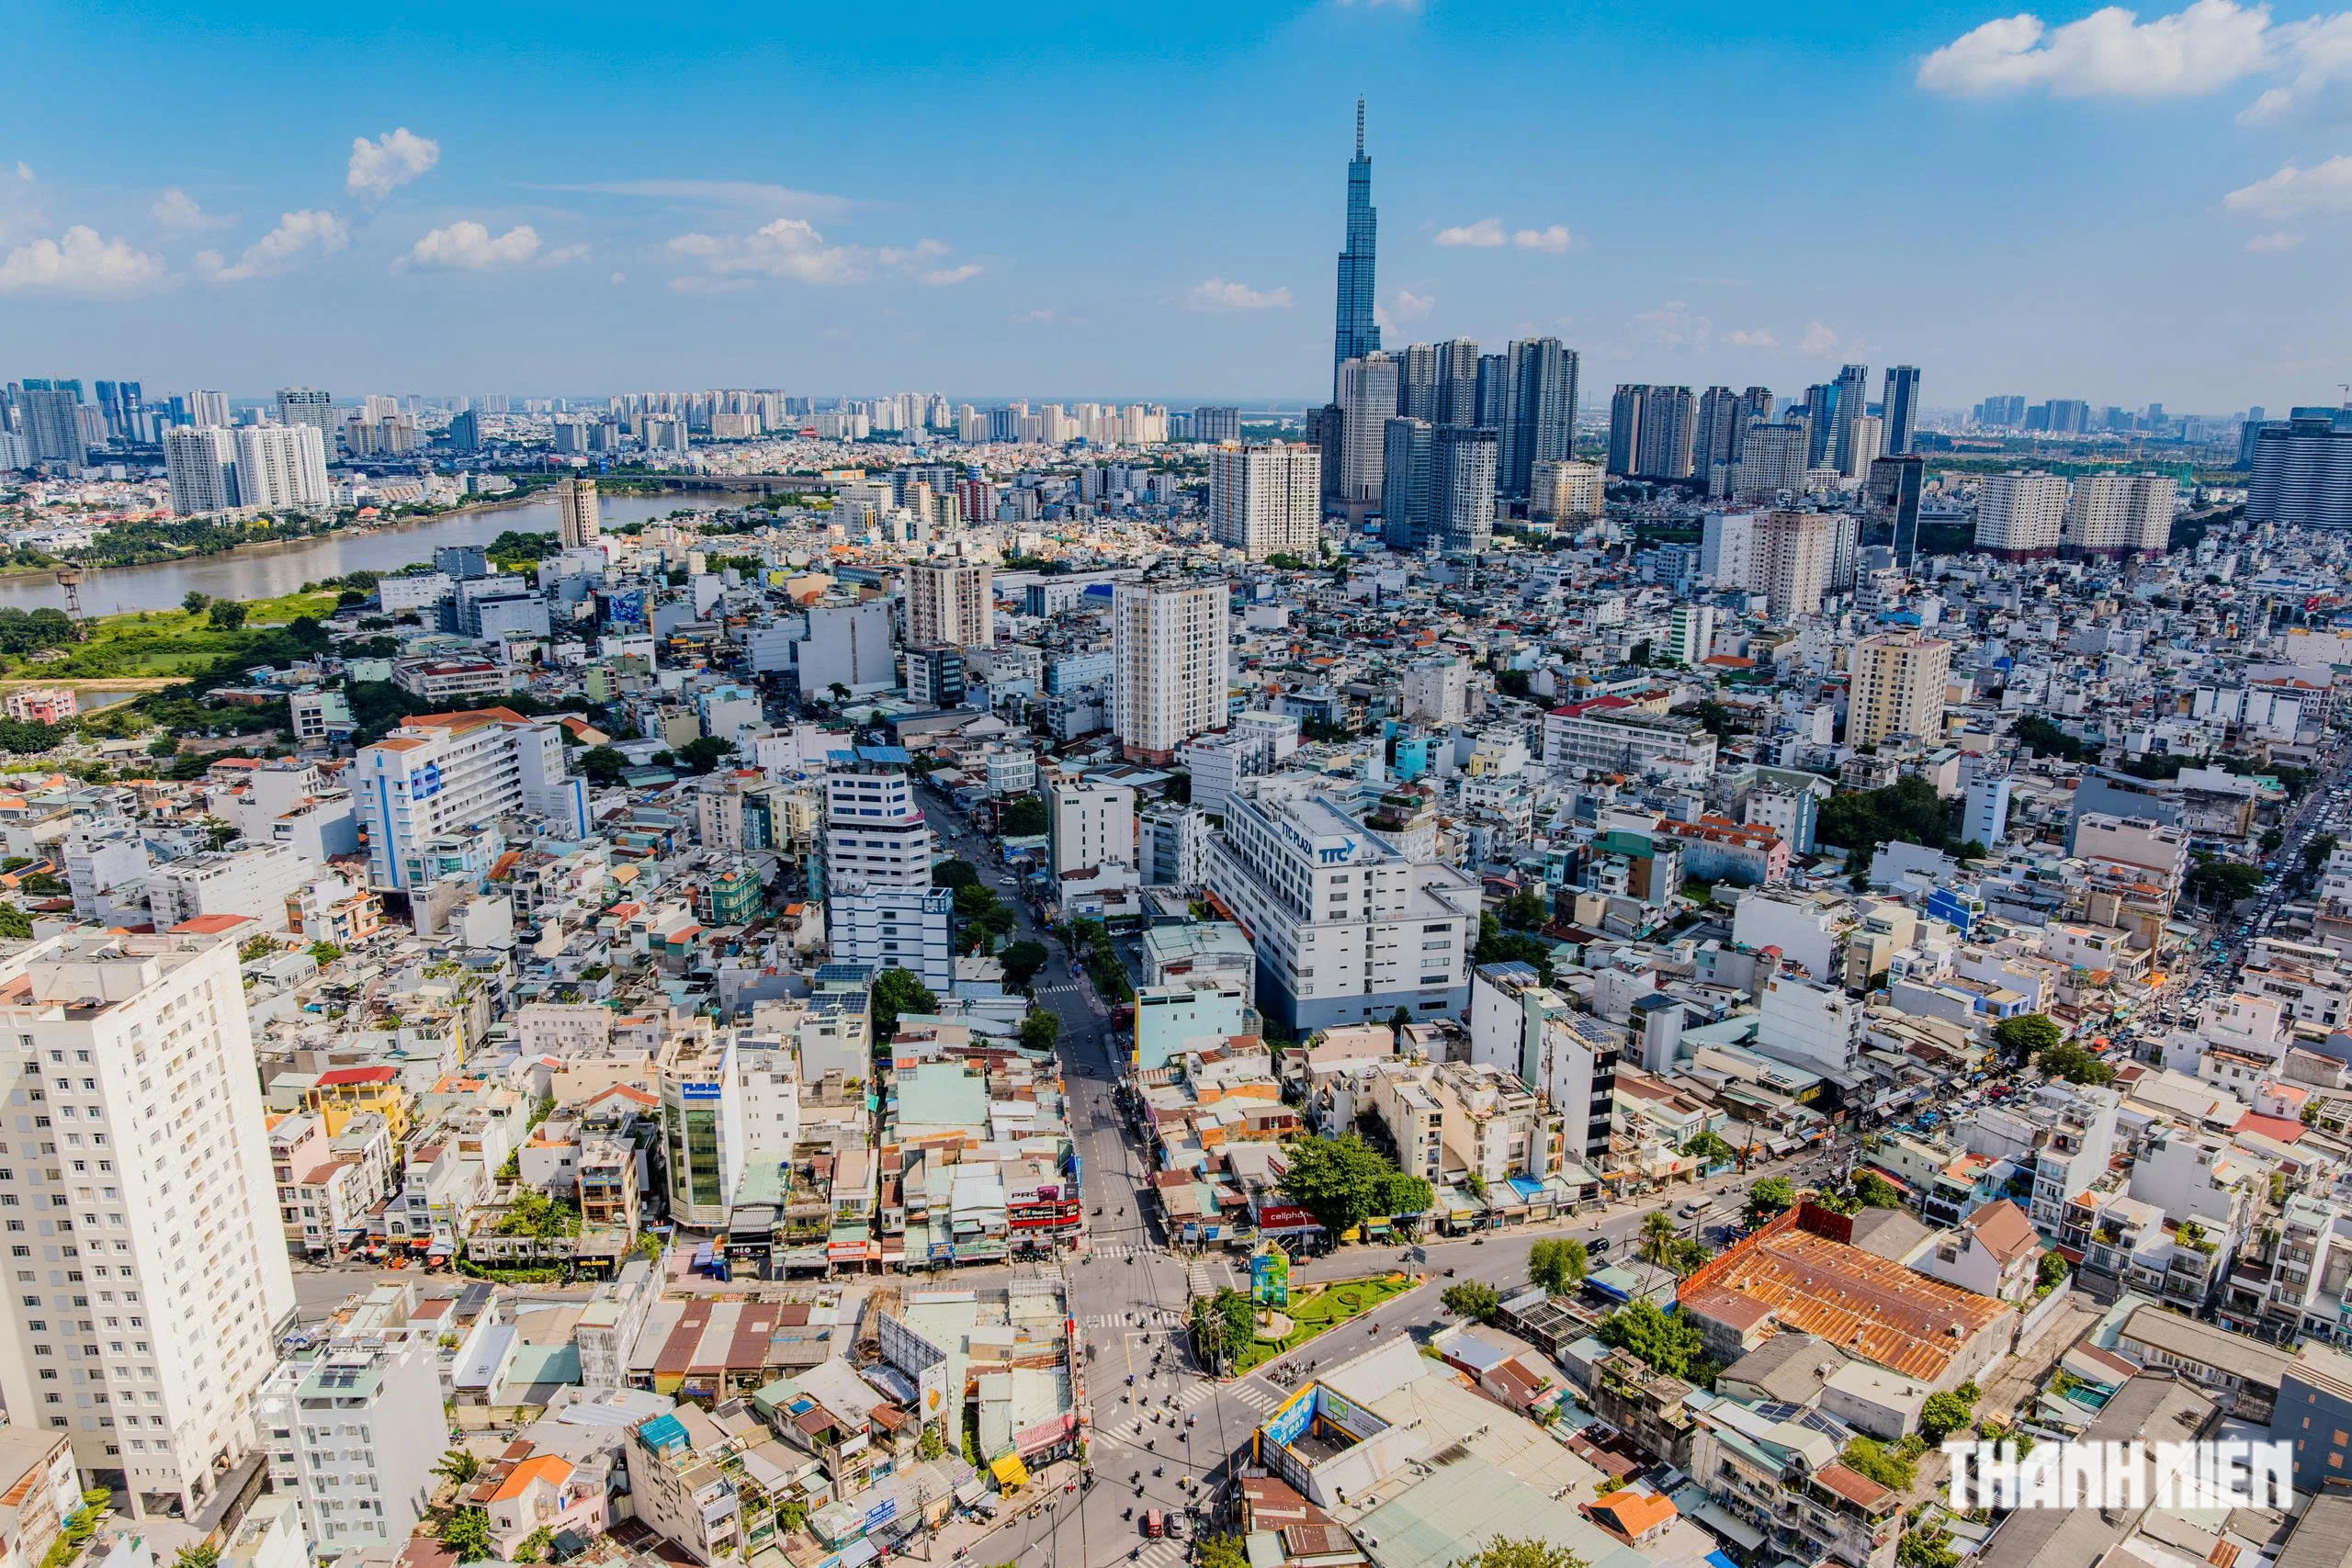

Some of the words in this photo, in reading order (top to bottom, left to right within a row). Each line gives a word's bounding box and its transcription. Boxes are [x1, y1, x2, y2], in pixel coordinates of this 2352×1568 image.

[1282, 821, 1293, 840] TTC
[1294, 831, 1313, 858] PLAZA
[1318, 848, 1349, 863] TTC
